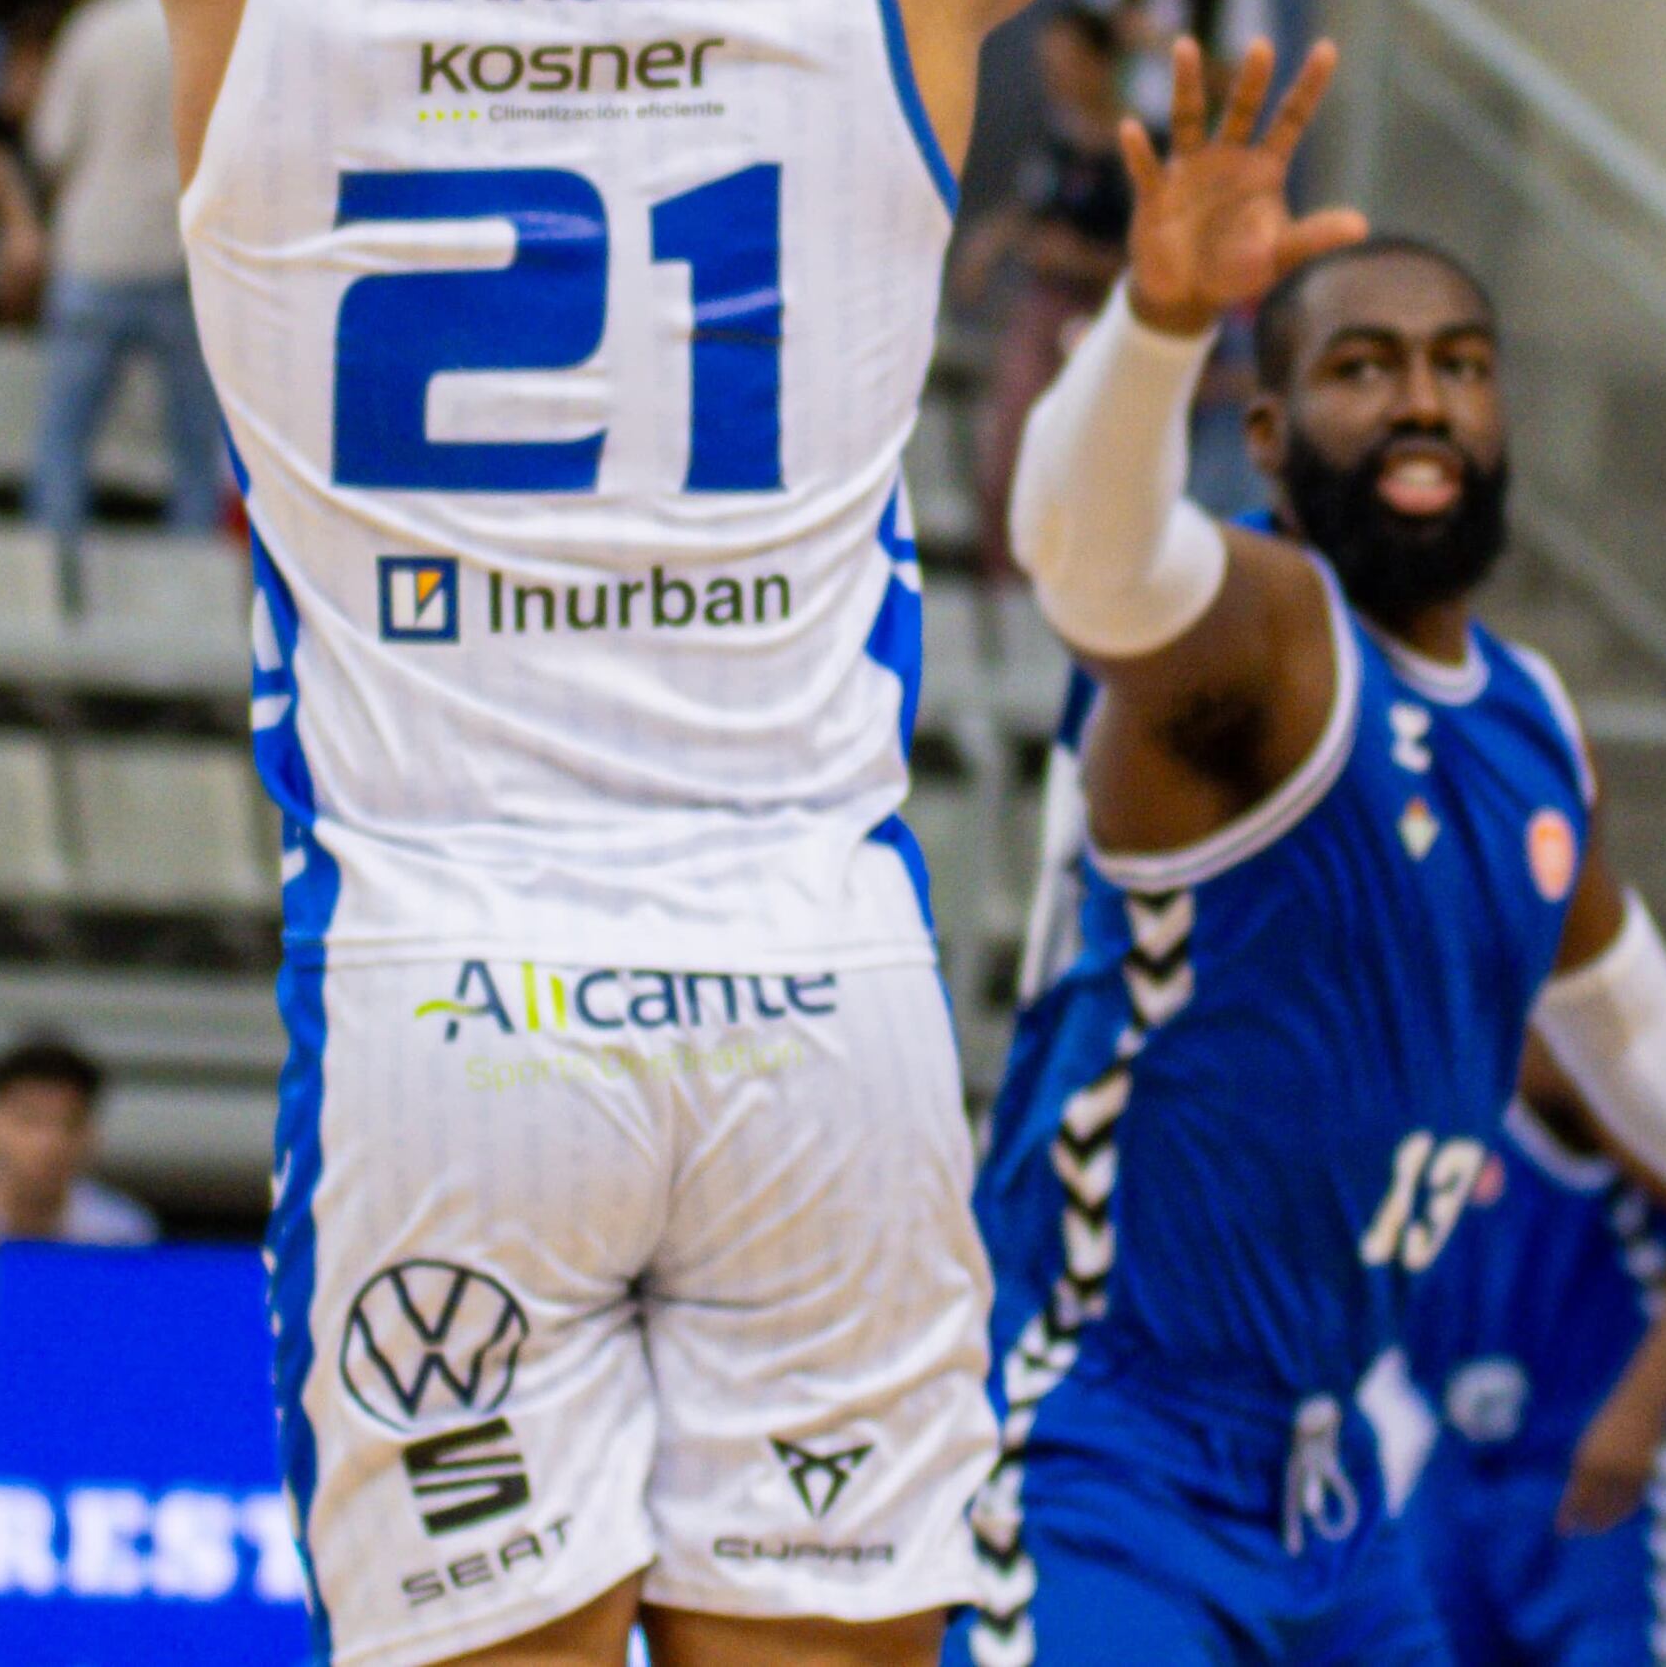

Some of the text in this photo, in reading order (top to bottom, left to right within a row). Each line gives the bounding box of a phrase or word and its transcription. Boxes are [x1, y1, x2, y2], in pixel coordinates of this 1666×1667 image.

[333, 162, 788, 495] 21
[487, 568, 793, 635] Inurban
[415, 959, 838, 1044] Alicante
[1361, 1131, 1484, 1271] 13
[401, 1513, 572, 1608] SEAT
[713, 1536, 895, 1566] CUPRA
